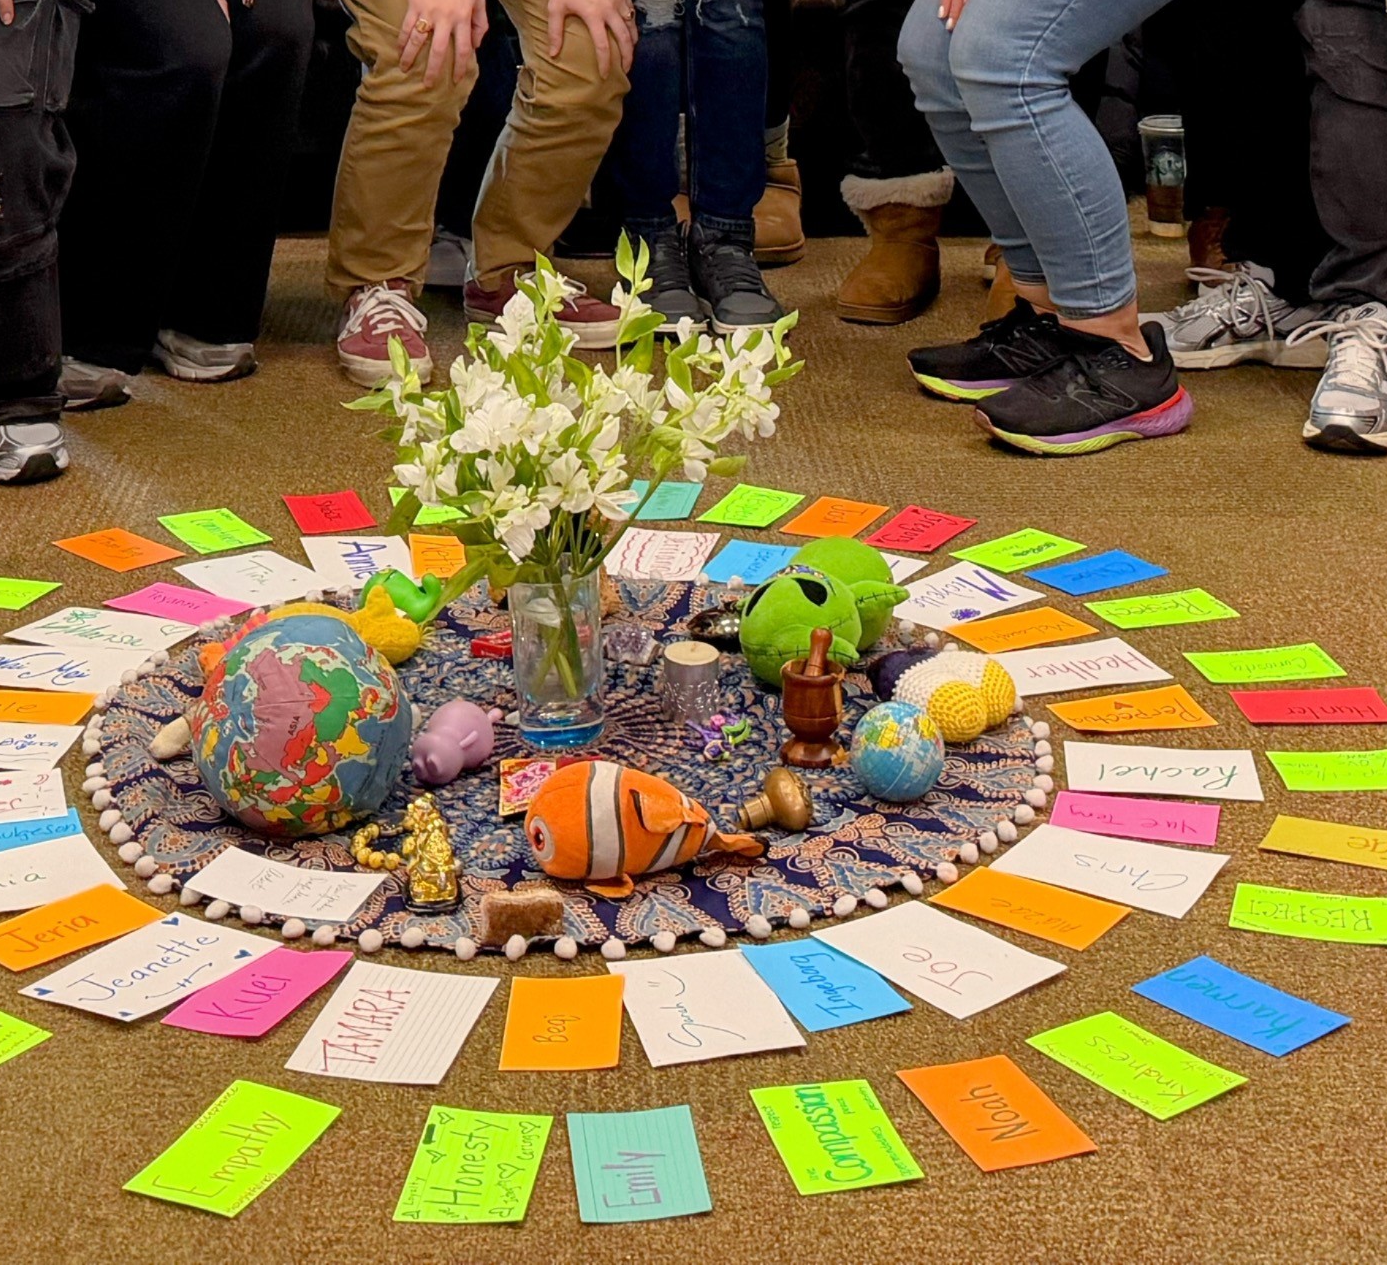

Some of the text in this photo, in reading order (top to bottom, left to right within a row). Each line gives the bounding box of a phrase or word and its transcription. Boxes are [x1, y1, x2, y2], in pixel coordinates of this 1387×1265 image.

[819, 504, 867, 525] Josh
[885, 513, 958, 544] Gregory
[337, 540, 387, 580] Annie
[1103, 595, 1210, 618] Respect
[1025, 649, 1152, 680] Heather
[287, 715, 301, 736] ASIA
[1286, 704, 1379, 718] Hunter
[1098, 763, 1239, 791] Rachel
[1140, 818, 1198, 835] Yue
[1074, 853, 1189, 892] Chris
[1234, 899, 1373, 932] RESPECT
[67, 932, 221, 1003] Jeanette
[902, 944, 994, 996] Joe
[195, 973, 293, 1021] Kuei
[1164, 967, 1307, 1046] Karmen
[319, 988, 411, 1072] TAMARA
[1084, 1035, 1198, 1103] Kindness
[794, 1084, 874, 1183] Compassion
[960, 1083, 1042, 1146] Noah
[152, 1110, 293, 1198] Empathy
[423, 1118, 510, 1207] Honesty
[601, 1150, 667, 1209] Emily
